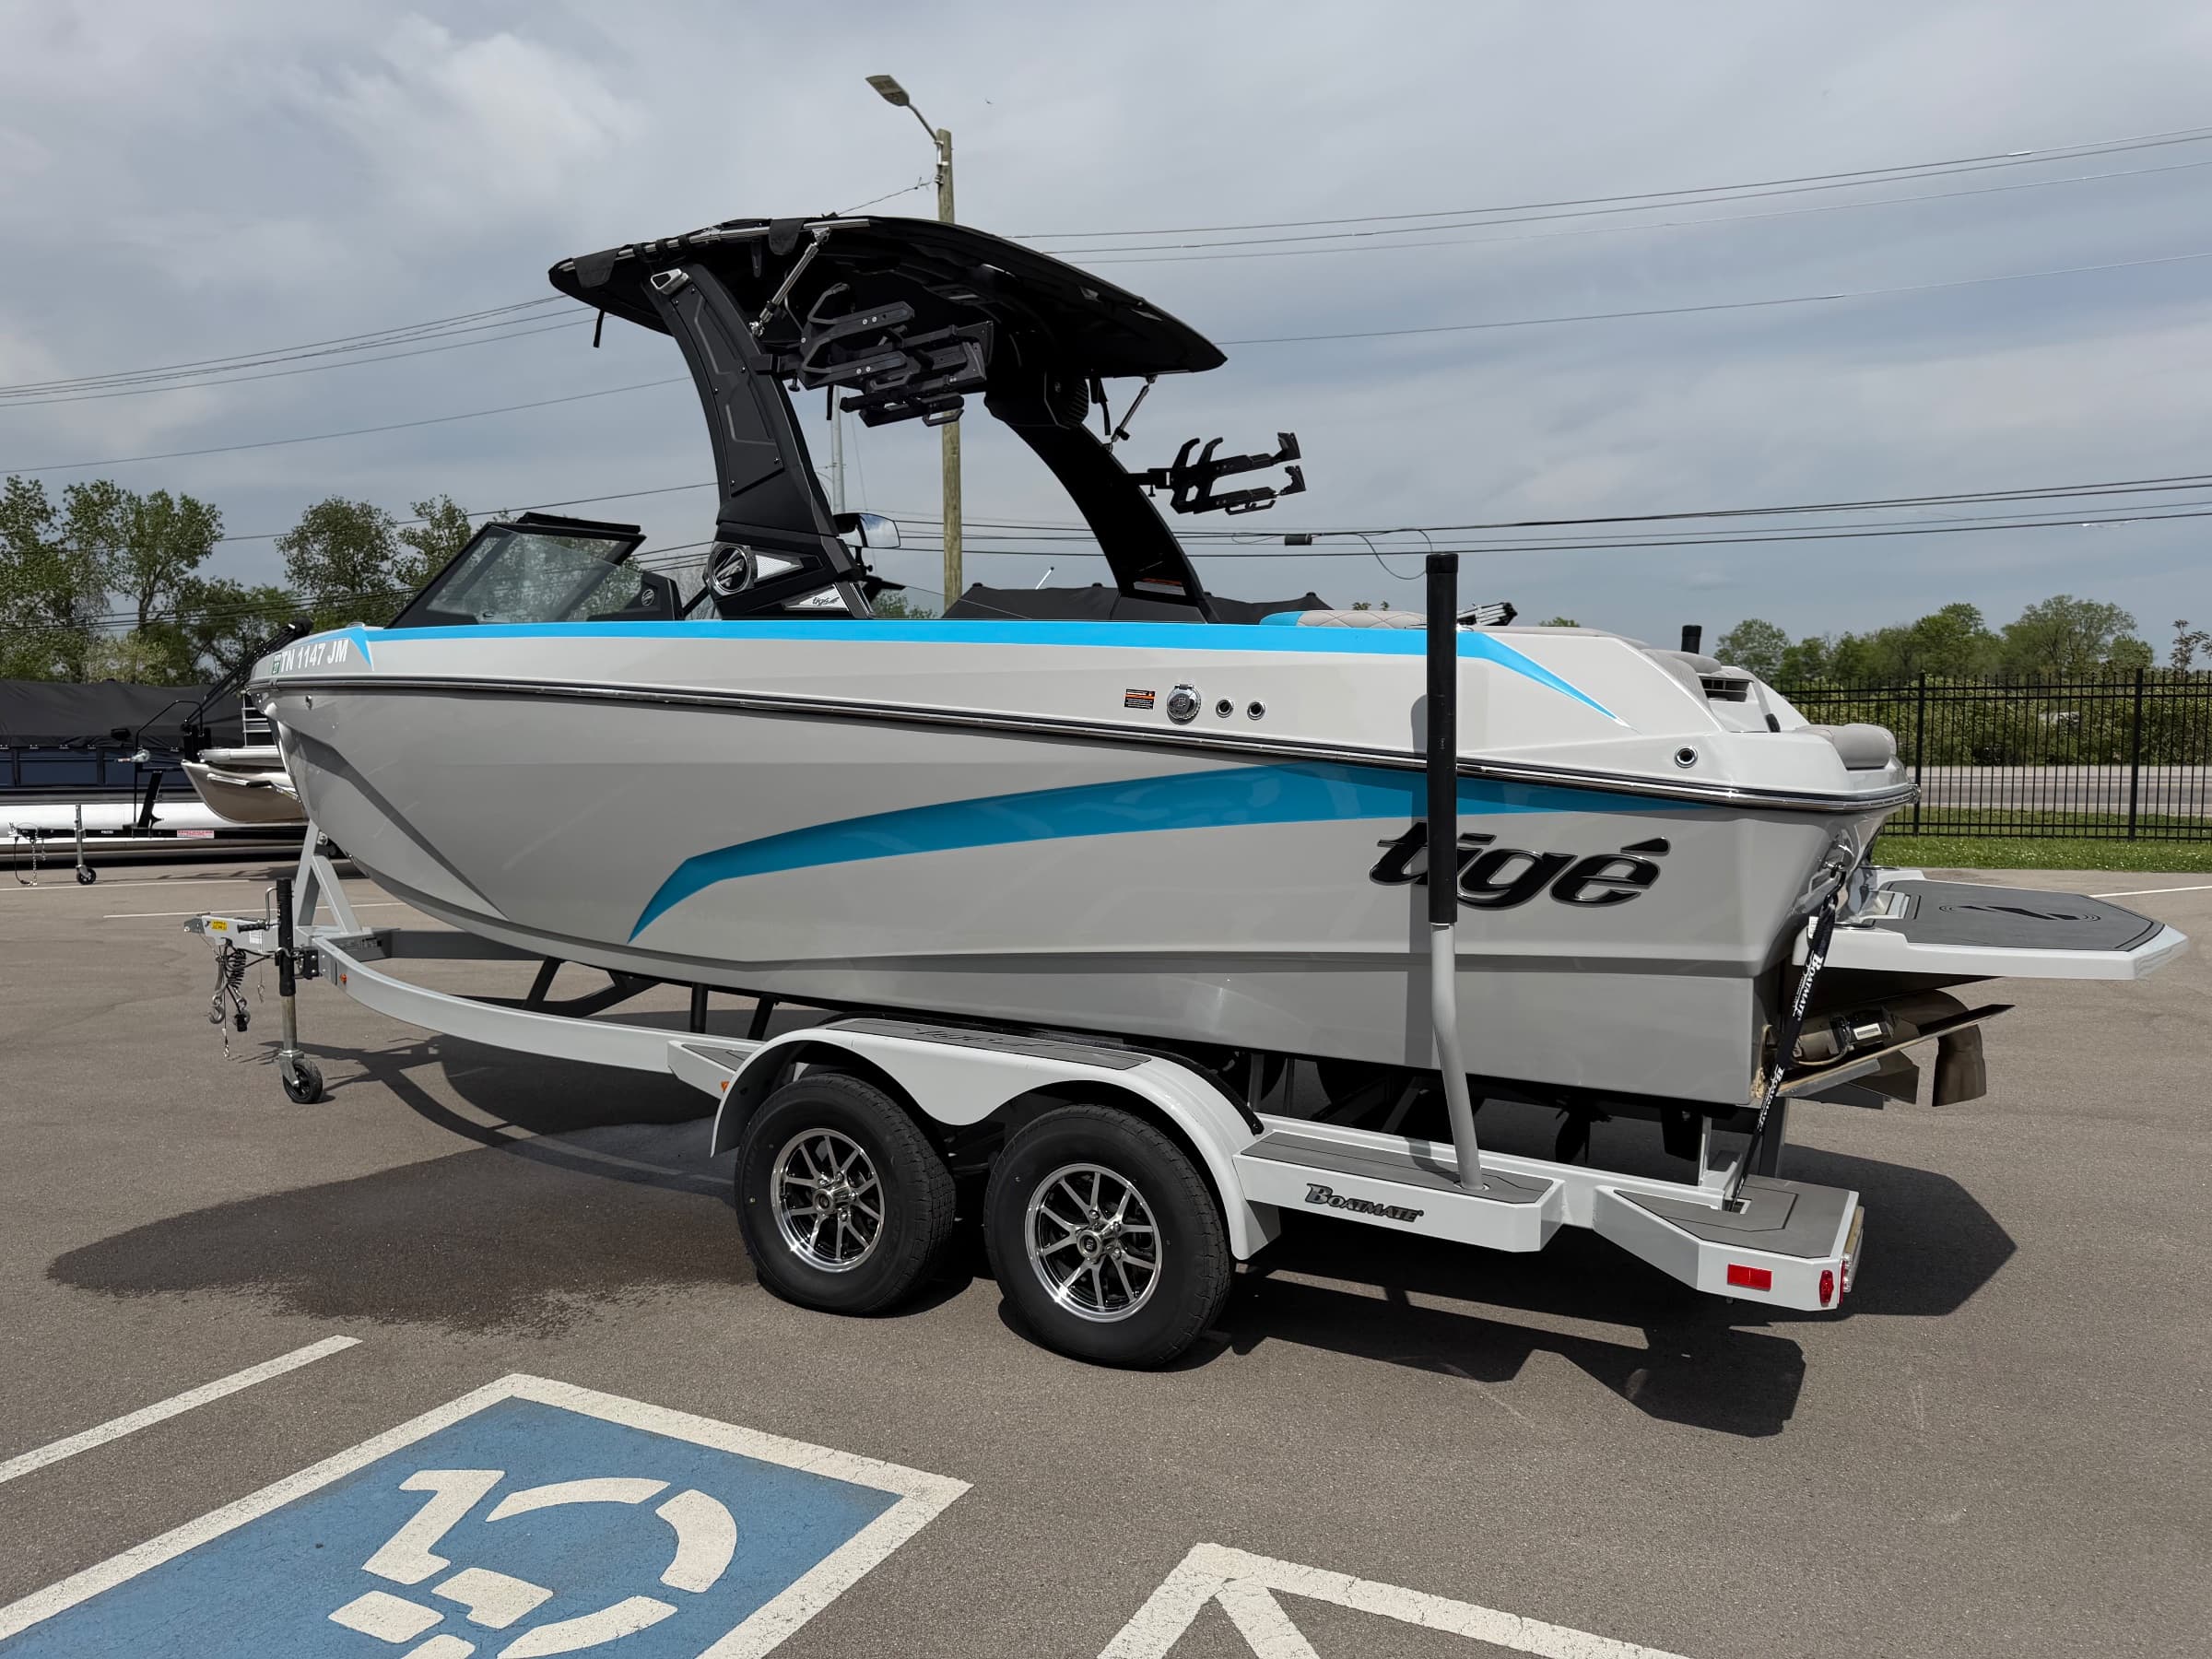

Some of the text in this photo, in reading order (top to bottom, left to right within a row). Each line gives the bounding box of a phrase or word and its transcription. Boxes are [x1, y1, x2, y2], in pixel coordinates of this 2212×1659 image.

[281, 639, 349, 673] TN 1147 JM
